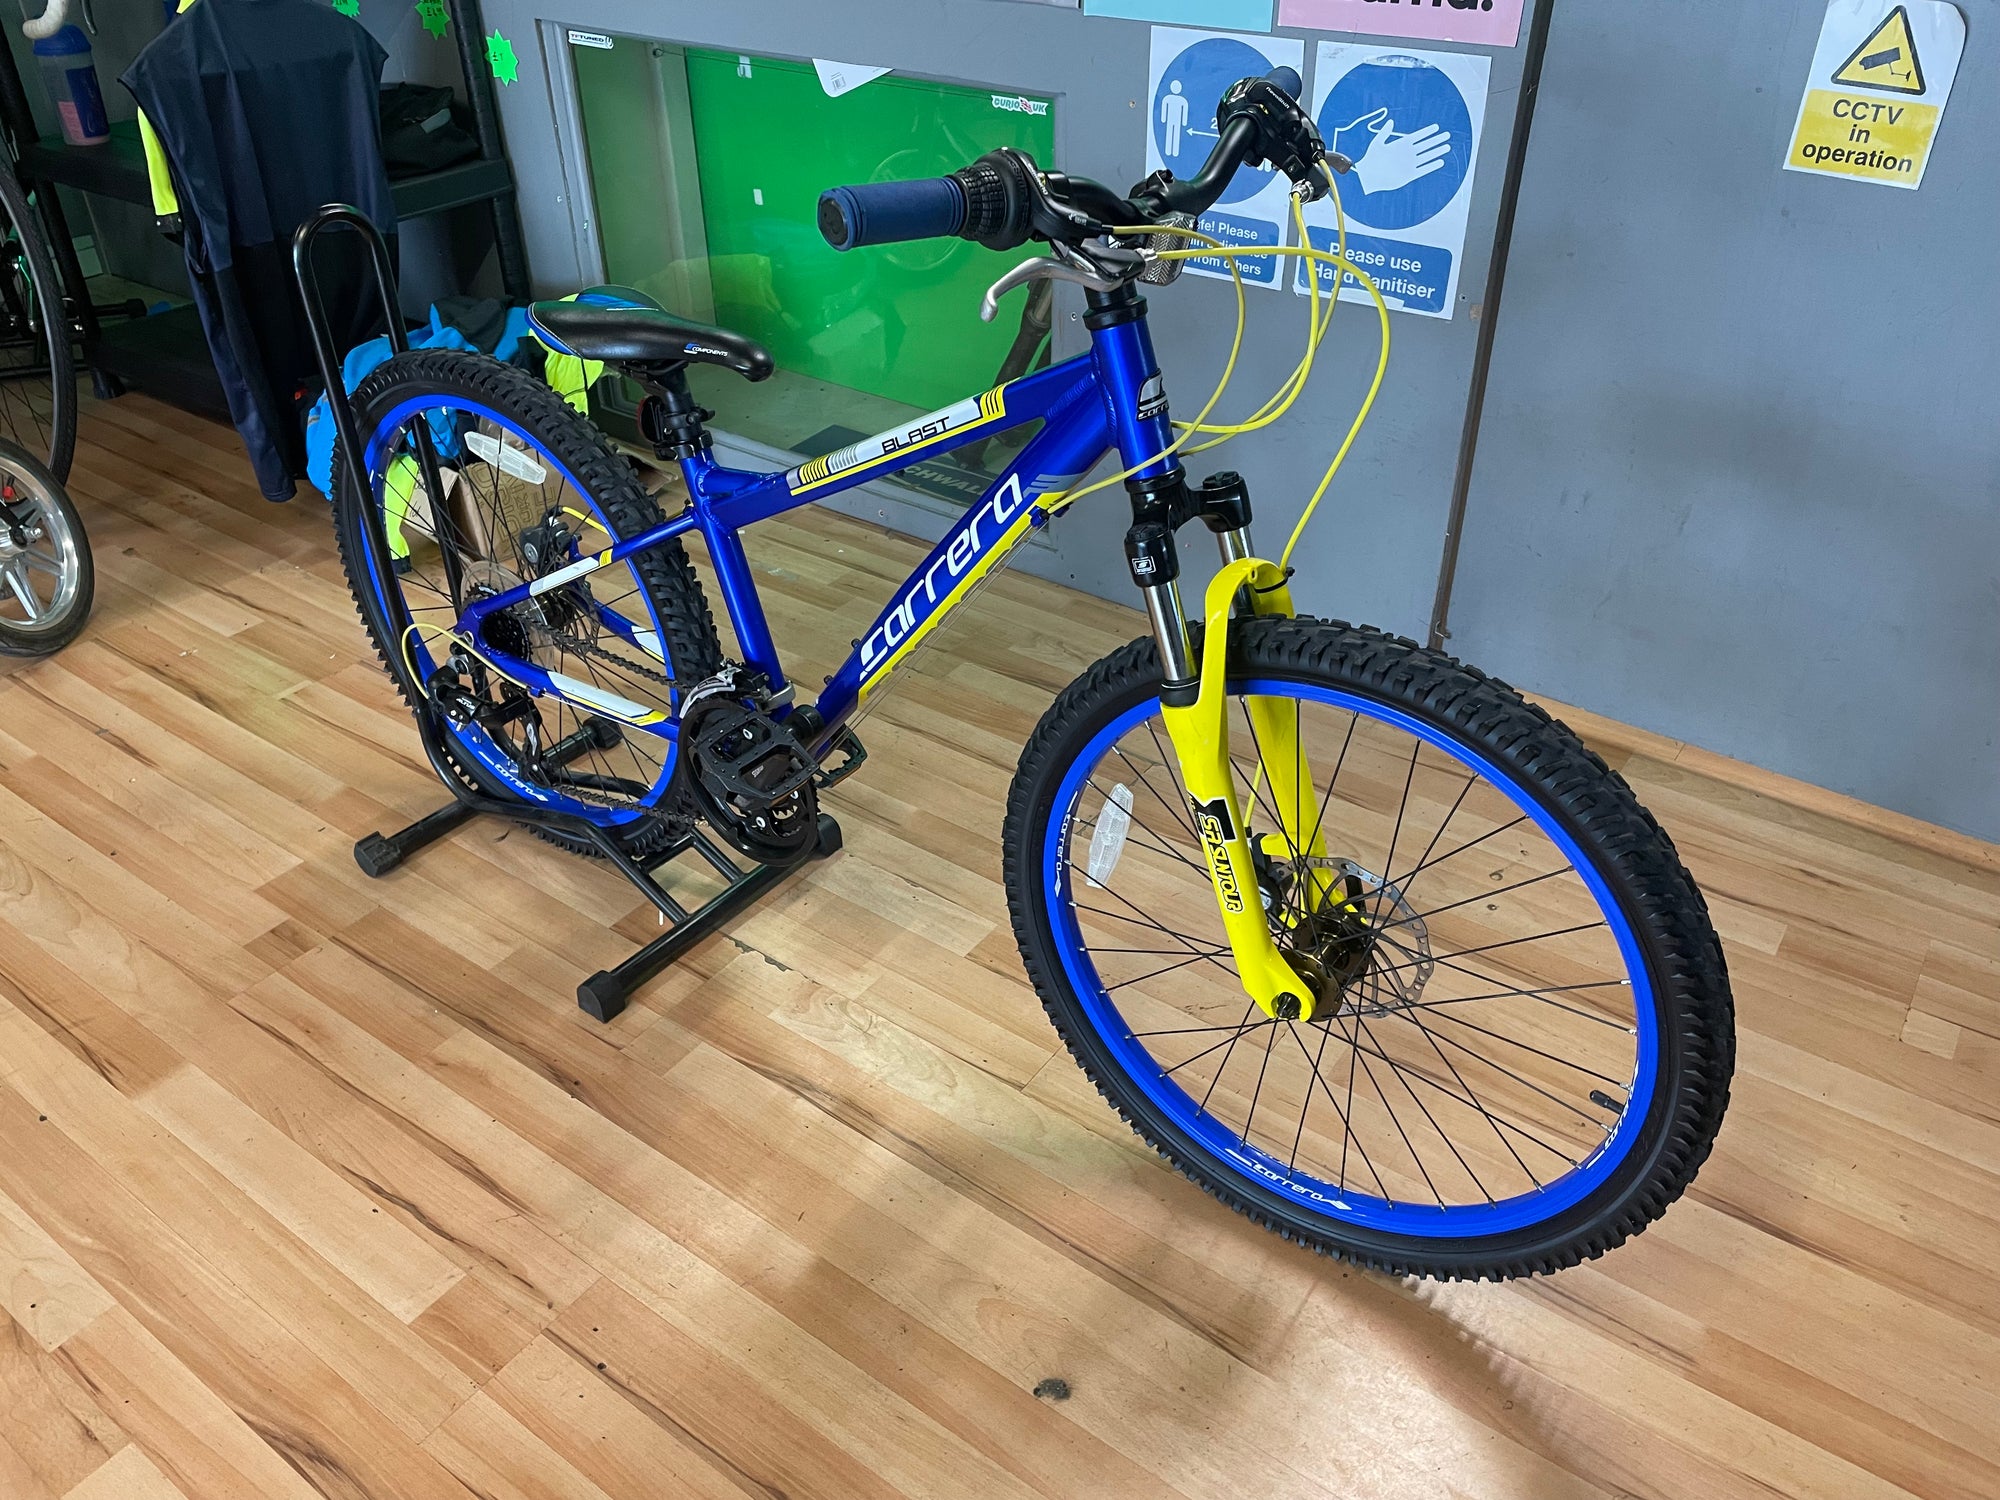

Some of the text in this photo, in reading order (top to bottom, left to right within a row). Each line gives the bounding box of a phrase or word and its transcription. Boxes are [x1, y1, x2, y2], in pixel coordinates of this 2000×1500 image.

[1032, 103, 1046, 113] UK
[1833, 99, 1904, 125] CCTV
[1848, 123, 1871, 144] in
[1802, 143, 1912, 173] operation
[1218, 222, 1258, 240] Please
[1223, 260, 1262, 275] ohers
[1329, 242, 1422, 273] Pease use
[881, 416, 949, 454] BLAST
[903, 465, 984, 496] CHWAL
[860, 472, 1023, 682] carrera
[1210, 844, 1243, 913] SUNTOUR
[1252, 1160, 1324, 1201] carrera
